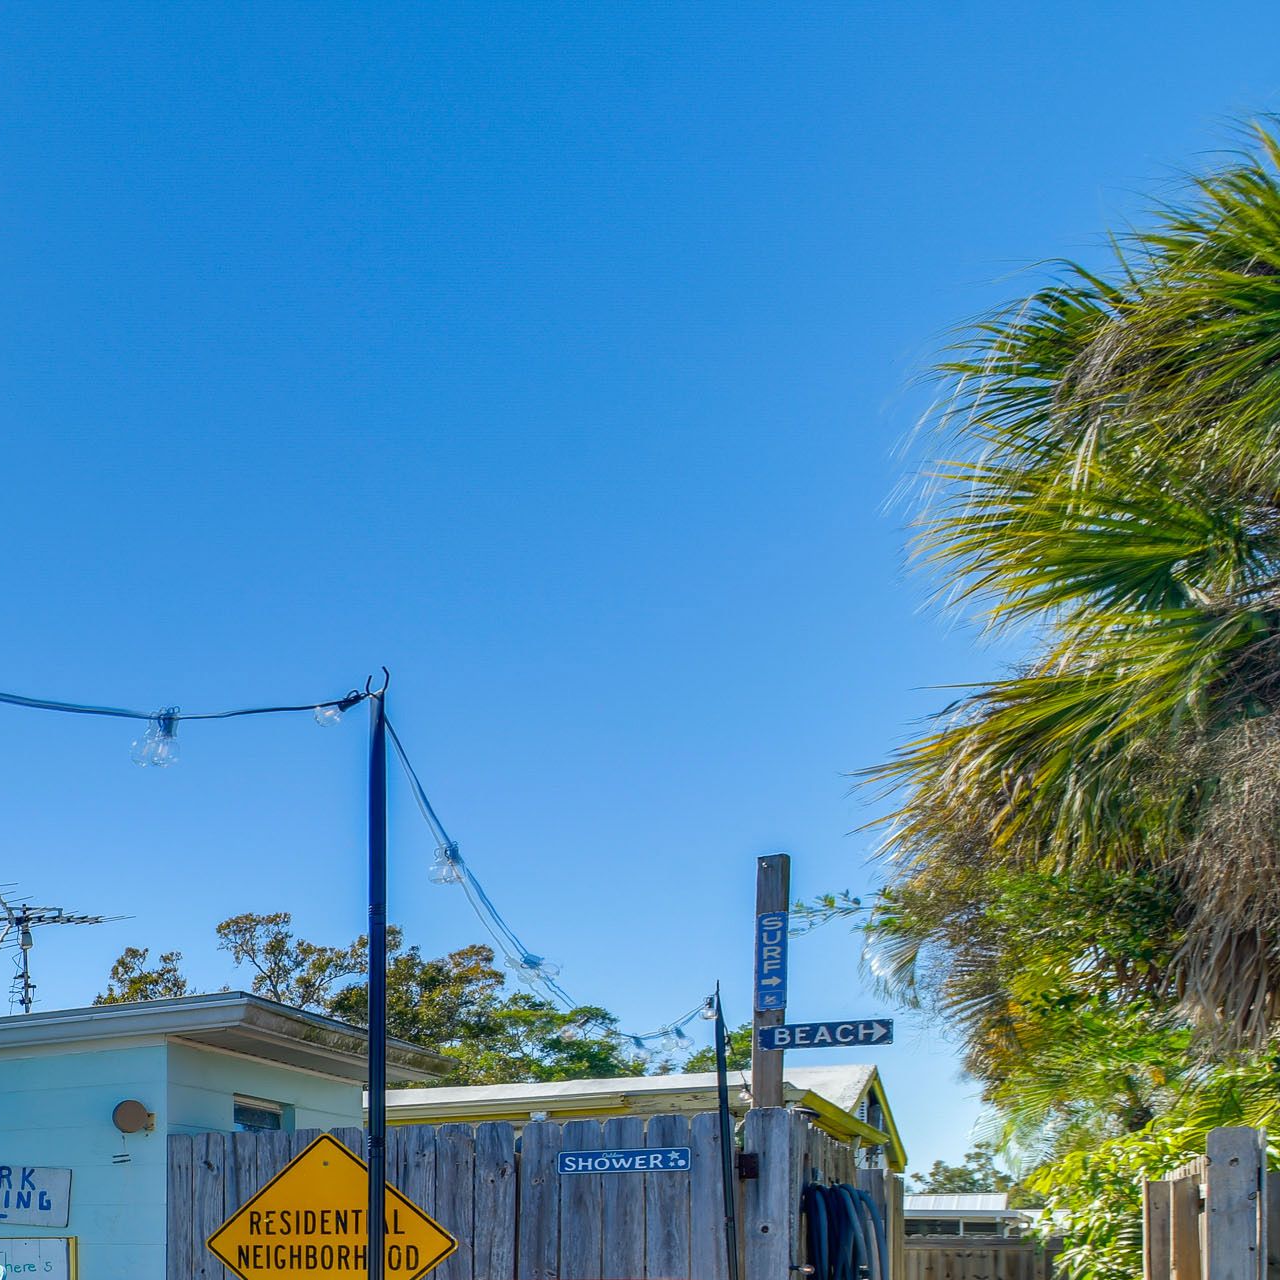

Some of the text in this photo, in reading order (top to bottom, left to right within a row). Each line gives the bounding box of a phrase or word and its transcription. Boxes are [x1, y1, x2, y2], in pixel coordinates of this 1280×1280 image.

[761, 917, 783, 974] SURF
[774, 1021, 876, 1046] BEACH
[564, 1154, 663, 1171] SHOWER
[237, 1244, 419, 1271] NEIGHBORHOD
